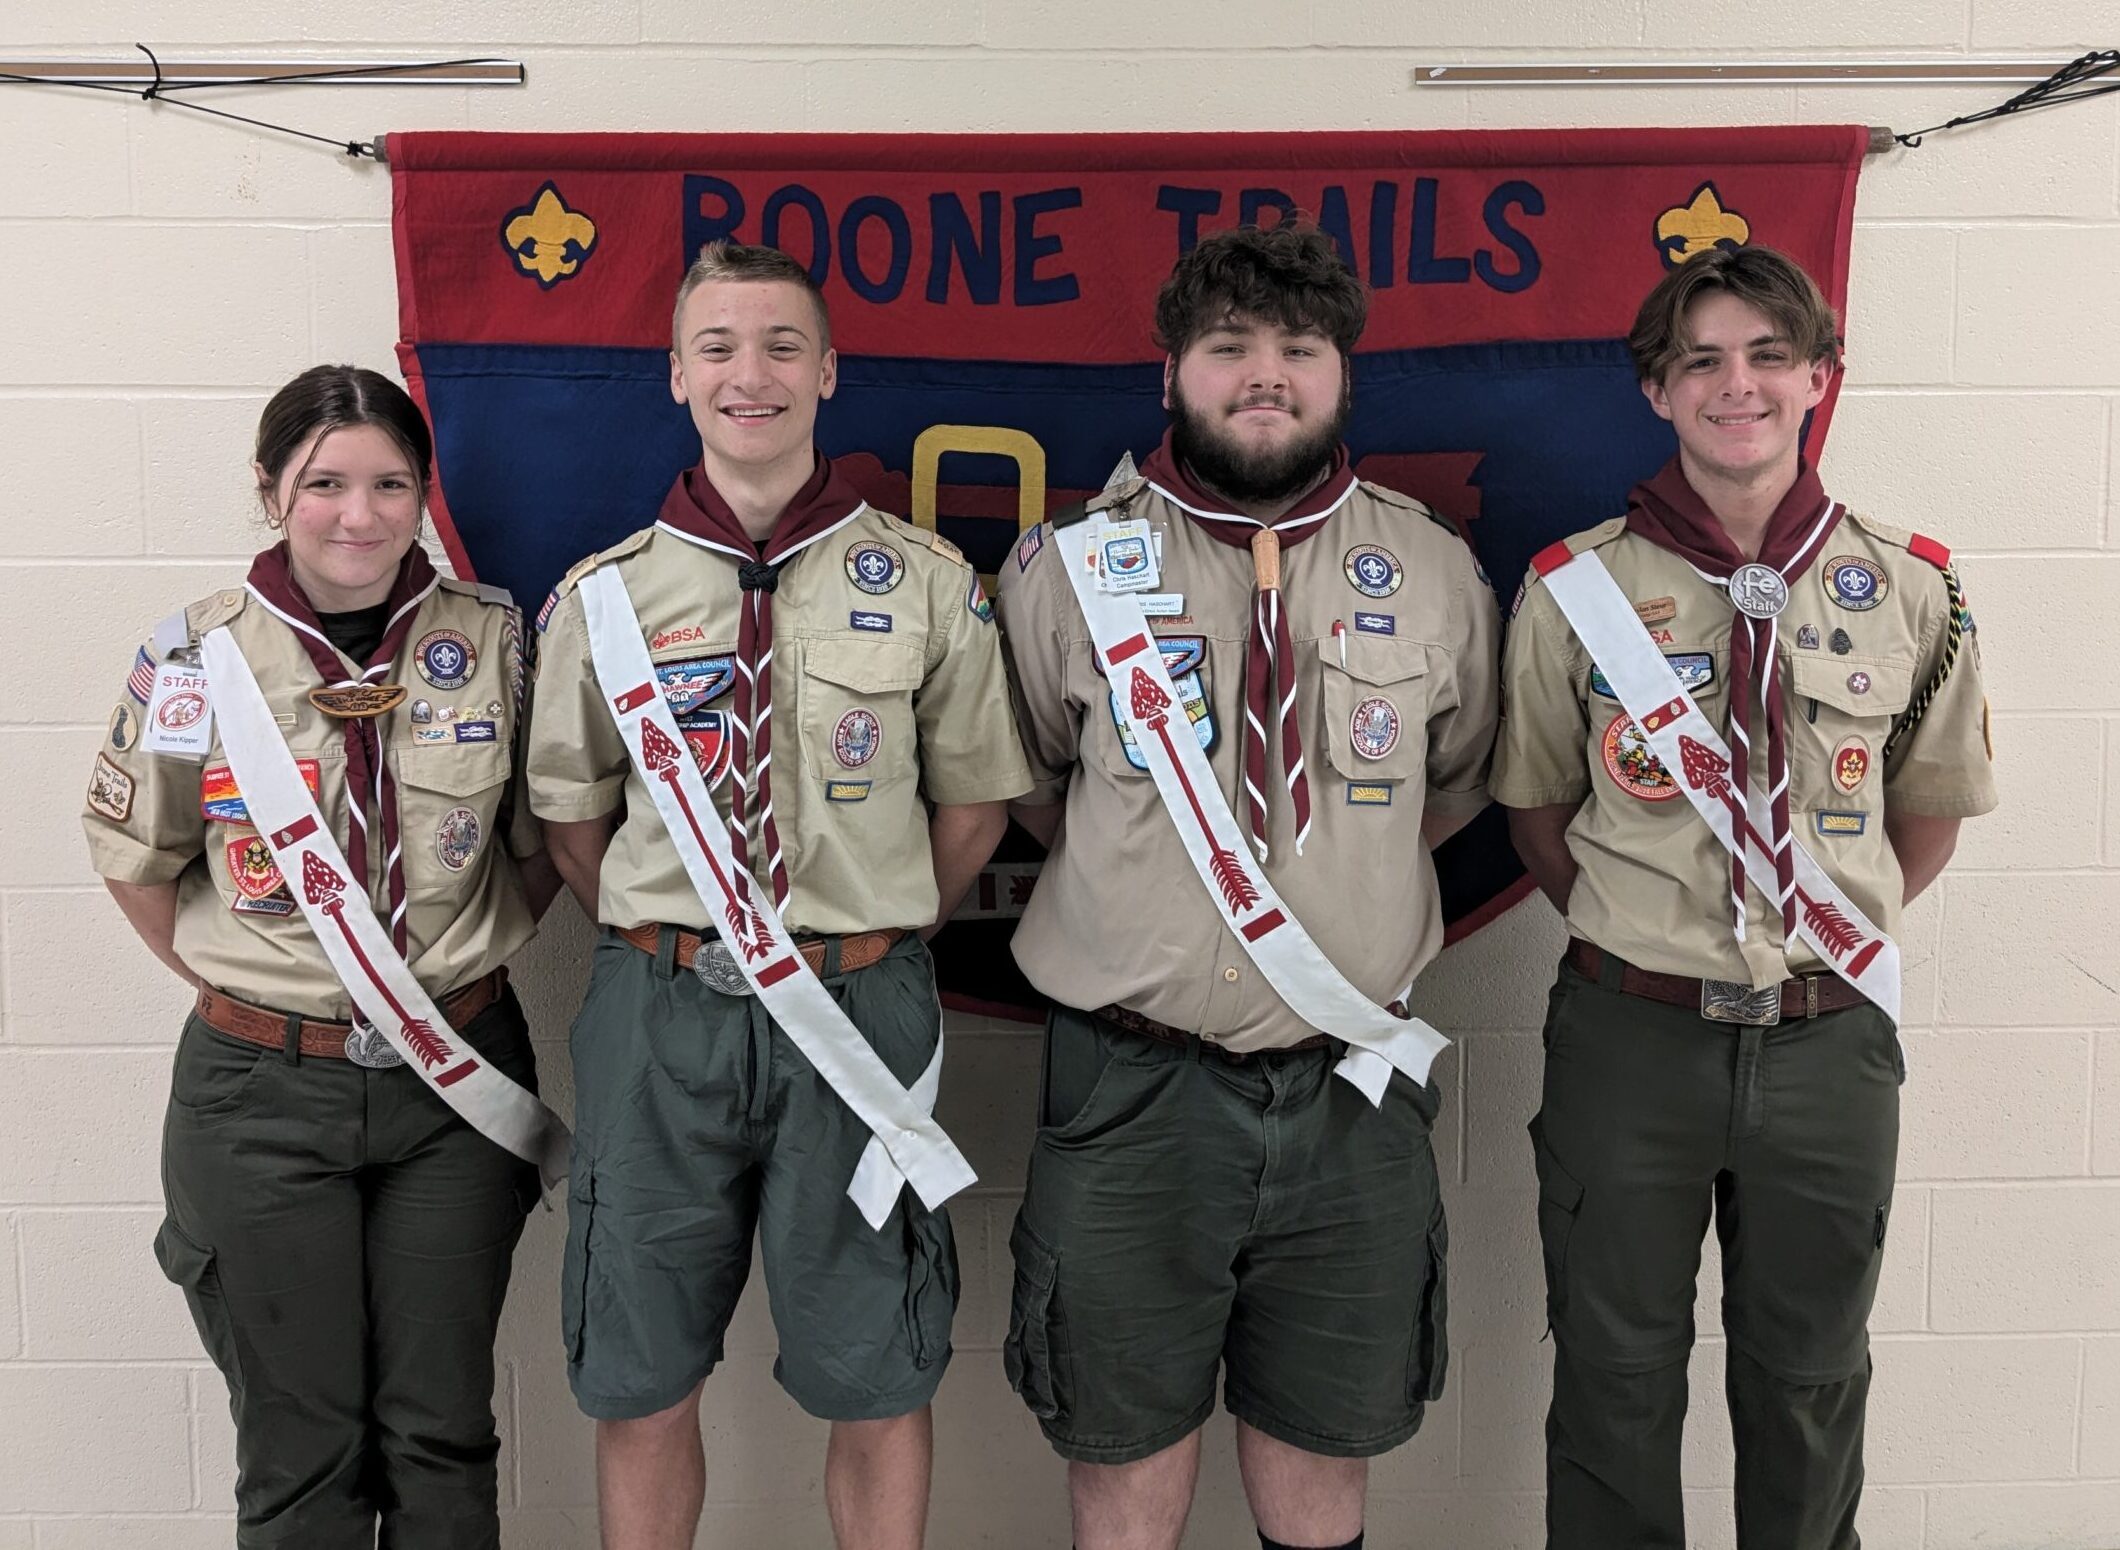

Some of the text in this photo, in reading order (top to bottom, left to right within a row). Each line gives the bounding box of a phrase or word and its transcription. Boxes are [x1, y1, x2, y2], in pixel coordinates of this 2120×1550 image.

[683, 174, 1082, 306] BOONE
[1743, 598, 1775, 611] Staff
[1161, 615, 1194, 626] AMERICA
[671, 626, 706, 643] BSA
[1650, 629, 1674, 644] SA
[1171, 640, 1200, 648] COUNCIL
[665, 665, 682, 673] LOUIS
[684, 663, 701, 671] AREA
[702, 659, 732, 668] COUNCIL
[1679, 656, 1709, 665] COUNCIL
[162, 675, 209, 690] STAFF
[661, 680, 703, 693] HAWNEE
[1361, 700, 1396, 720] EAGLE SCOUT
[841, 711, 876, 728] EAGLE SCOUT
[180, 736, 199, 744] Kipper
[112, 770, 128, 788] Trails
[229, 847, 242, 879] GREATER
[245, 884, 263, 896] LOUIS
[246, 900, 290, 912] RECRUITER
